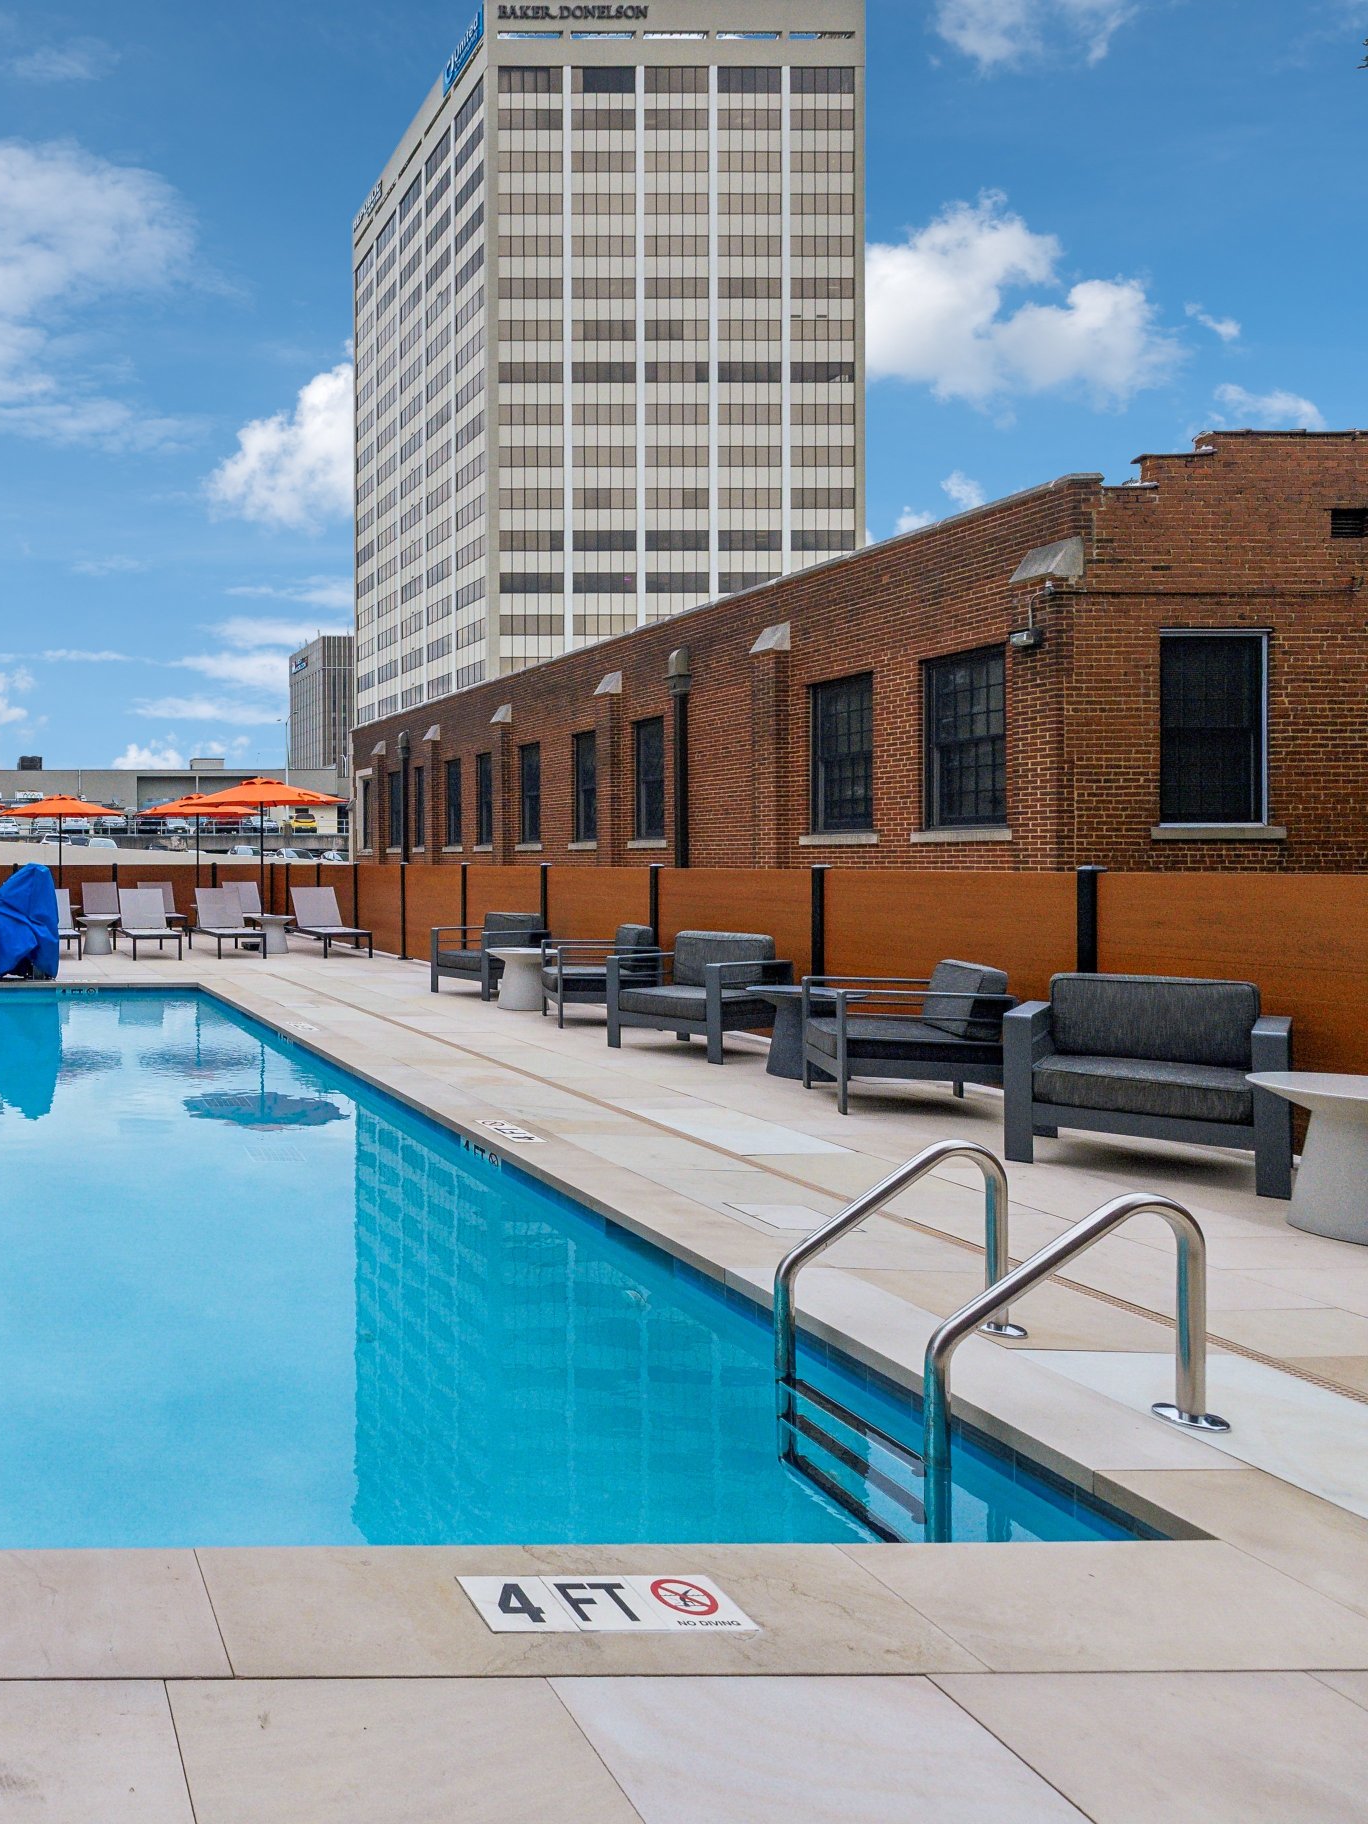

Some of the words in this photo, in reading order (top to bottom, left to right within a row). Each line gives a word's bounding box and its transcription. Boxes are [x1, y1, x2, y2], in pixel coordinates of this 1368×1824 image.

[498, 5, 558, 19] BAKER
[558, 5, 649, 19] DONELSON
[454, 11, 479, 62] United
[473, 1143, 486, 1160] FT
[497, 1583, 546, 1623] 4
[552, 1582, 641, 1622] FT
